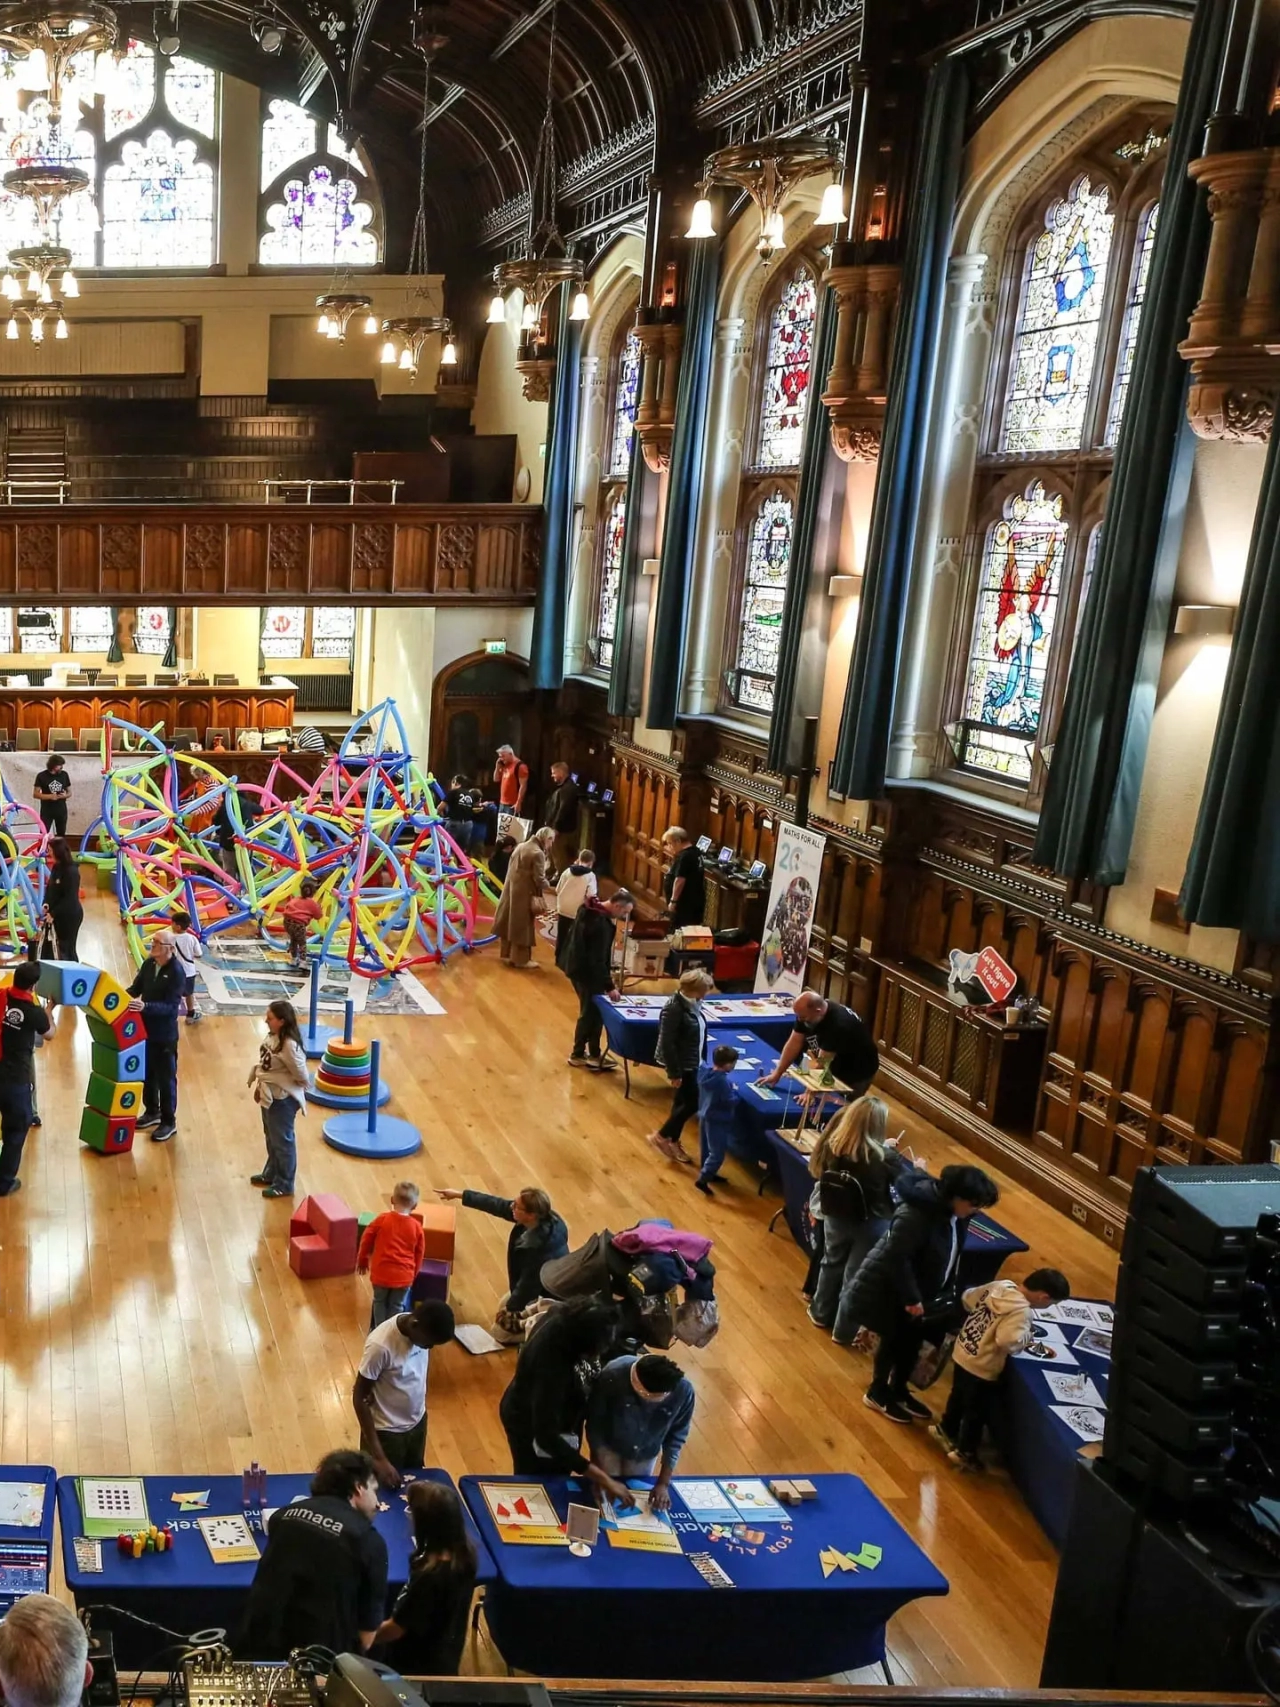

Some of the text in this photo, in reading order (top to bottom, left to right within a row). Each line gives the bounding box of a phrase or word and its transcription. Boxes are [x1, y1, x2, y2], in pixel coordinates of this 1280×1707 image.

[783, 827, 821, 849] MATHS FOR ALL
[981, 951, 1011, 989] Let's figure
[981, 966, 989, 977] it
[74, 982, 85, 995] 6
[107, 995, 117, 1008] 5
[124, 1023, 135, 1036] 4
[128, 1057, 137, 1071] 3
[123, 1093, 134, 1107] 2
[166, 1520, 200, 1532] eek
[283, 1508, 344, 1533] mmaca
[675, 1522, 714, 1534] Mat
[724, 1535, 793, 1556] FOR ALL
